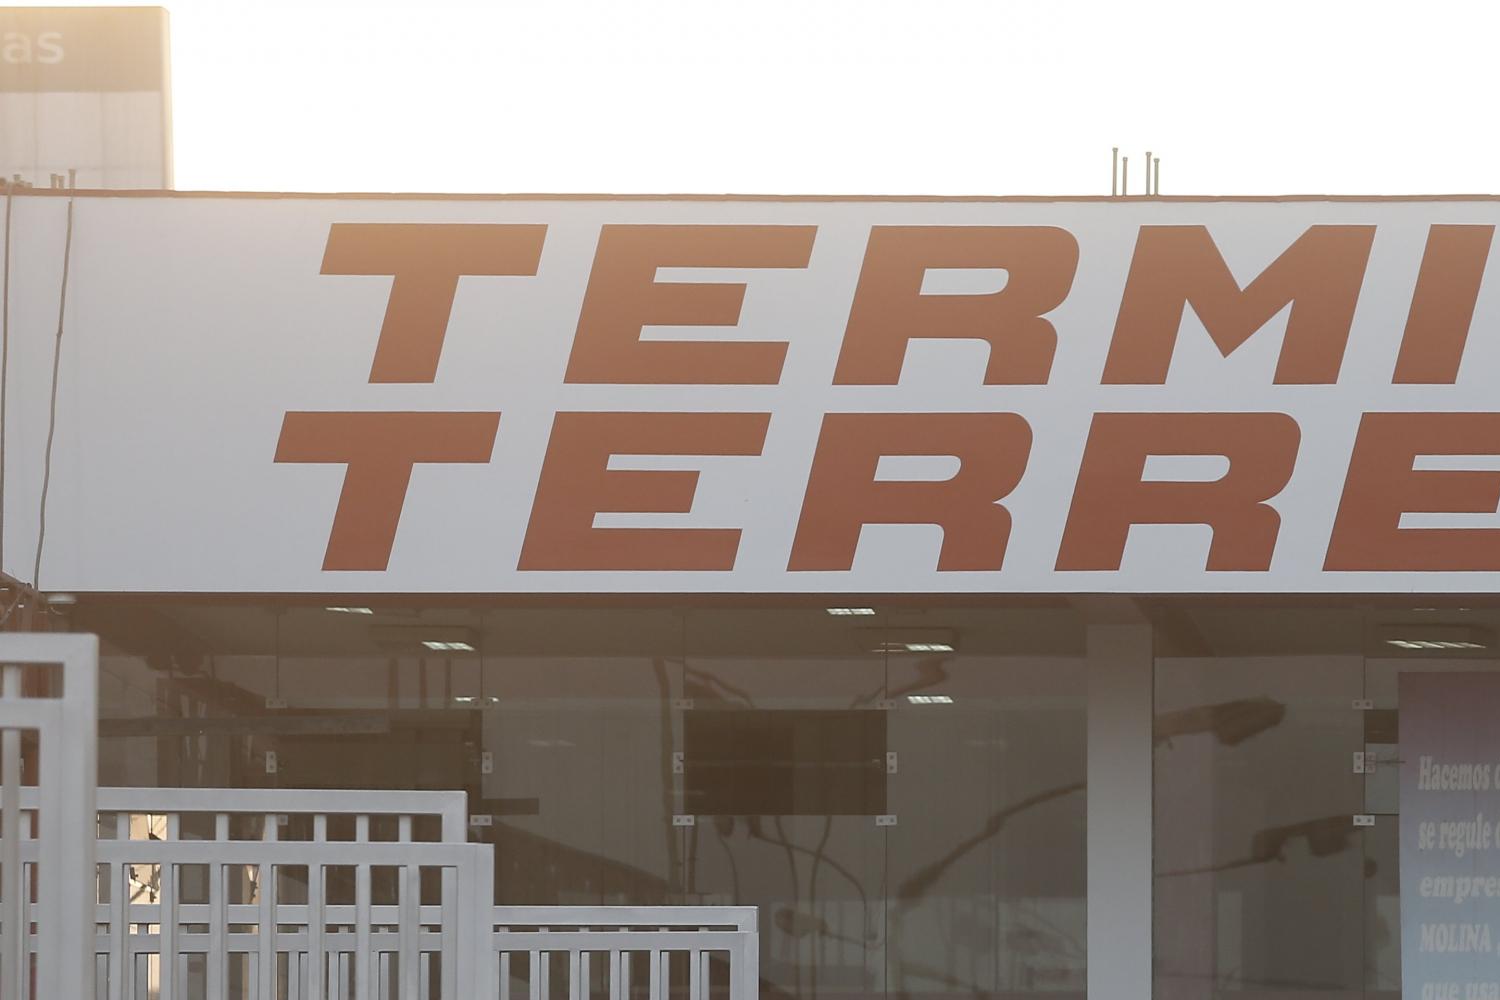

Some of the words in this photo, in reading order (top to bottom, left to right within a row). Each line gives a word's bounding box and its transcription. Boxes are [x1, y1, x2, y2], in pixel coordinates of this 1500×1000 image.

[1419, 756, 1491, 790] Hacemos
[1419, 821, 1436, 848] se
[1440, 813, 1491, 857] regule
[1420, 924, 1492, 952] MOLINA
